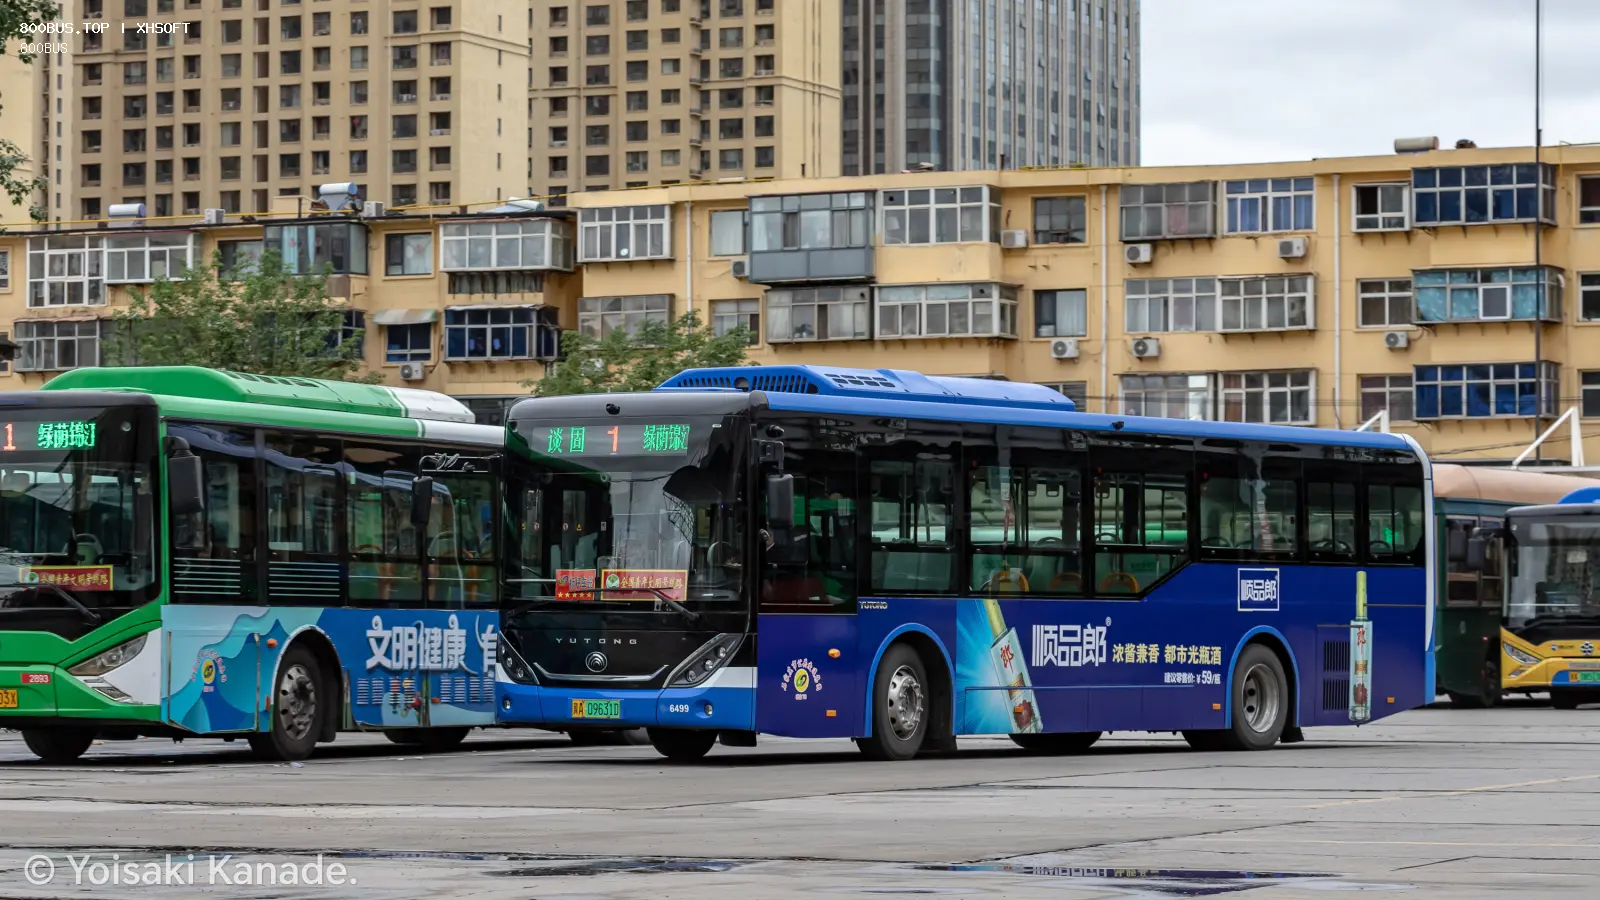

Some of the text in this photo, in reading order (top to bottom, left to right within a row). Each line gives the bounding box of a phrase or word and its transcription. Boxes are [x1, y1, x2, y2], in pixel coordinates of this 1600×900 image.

[3, 423, 17, 451] 1
[606, 425, 619, 455] 1
[1240, 579, 1277, 601] 顺品郎
[366, 614, 478, 674] 文明健康
[1112, 643, 1222, 666] 浓酱兼香 都市光瓶酒
[29, 674, 49, 683] 2893
[669, 704, 690, 713] 6499
